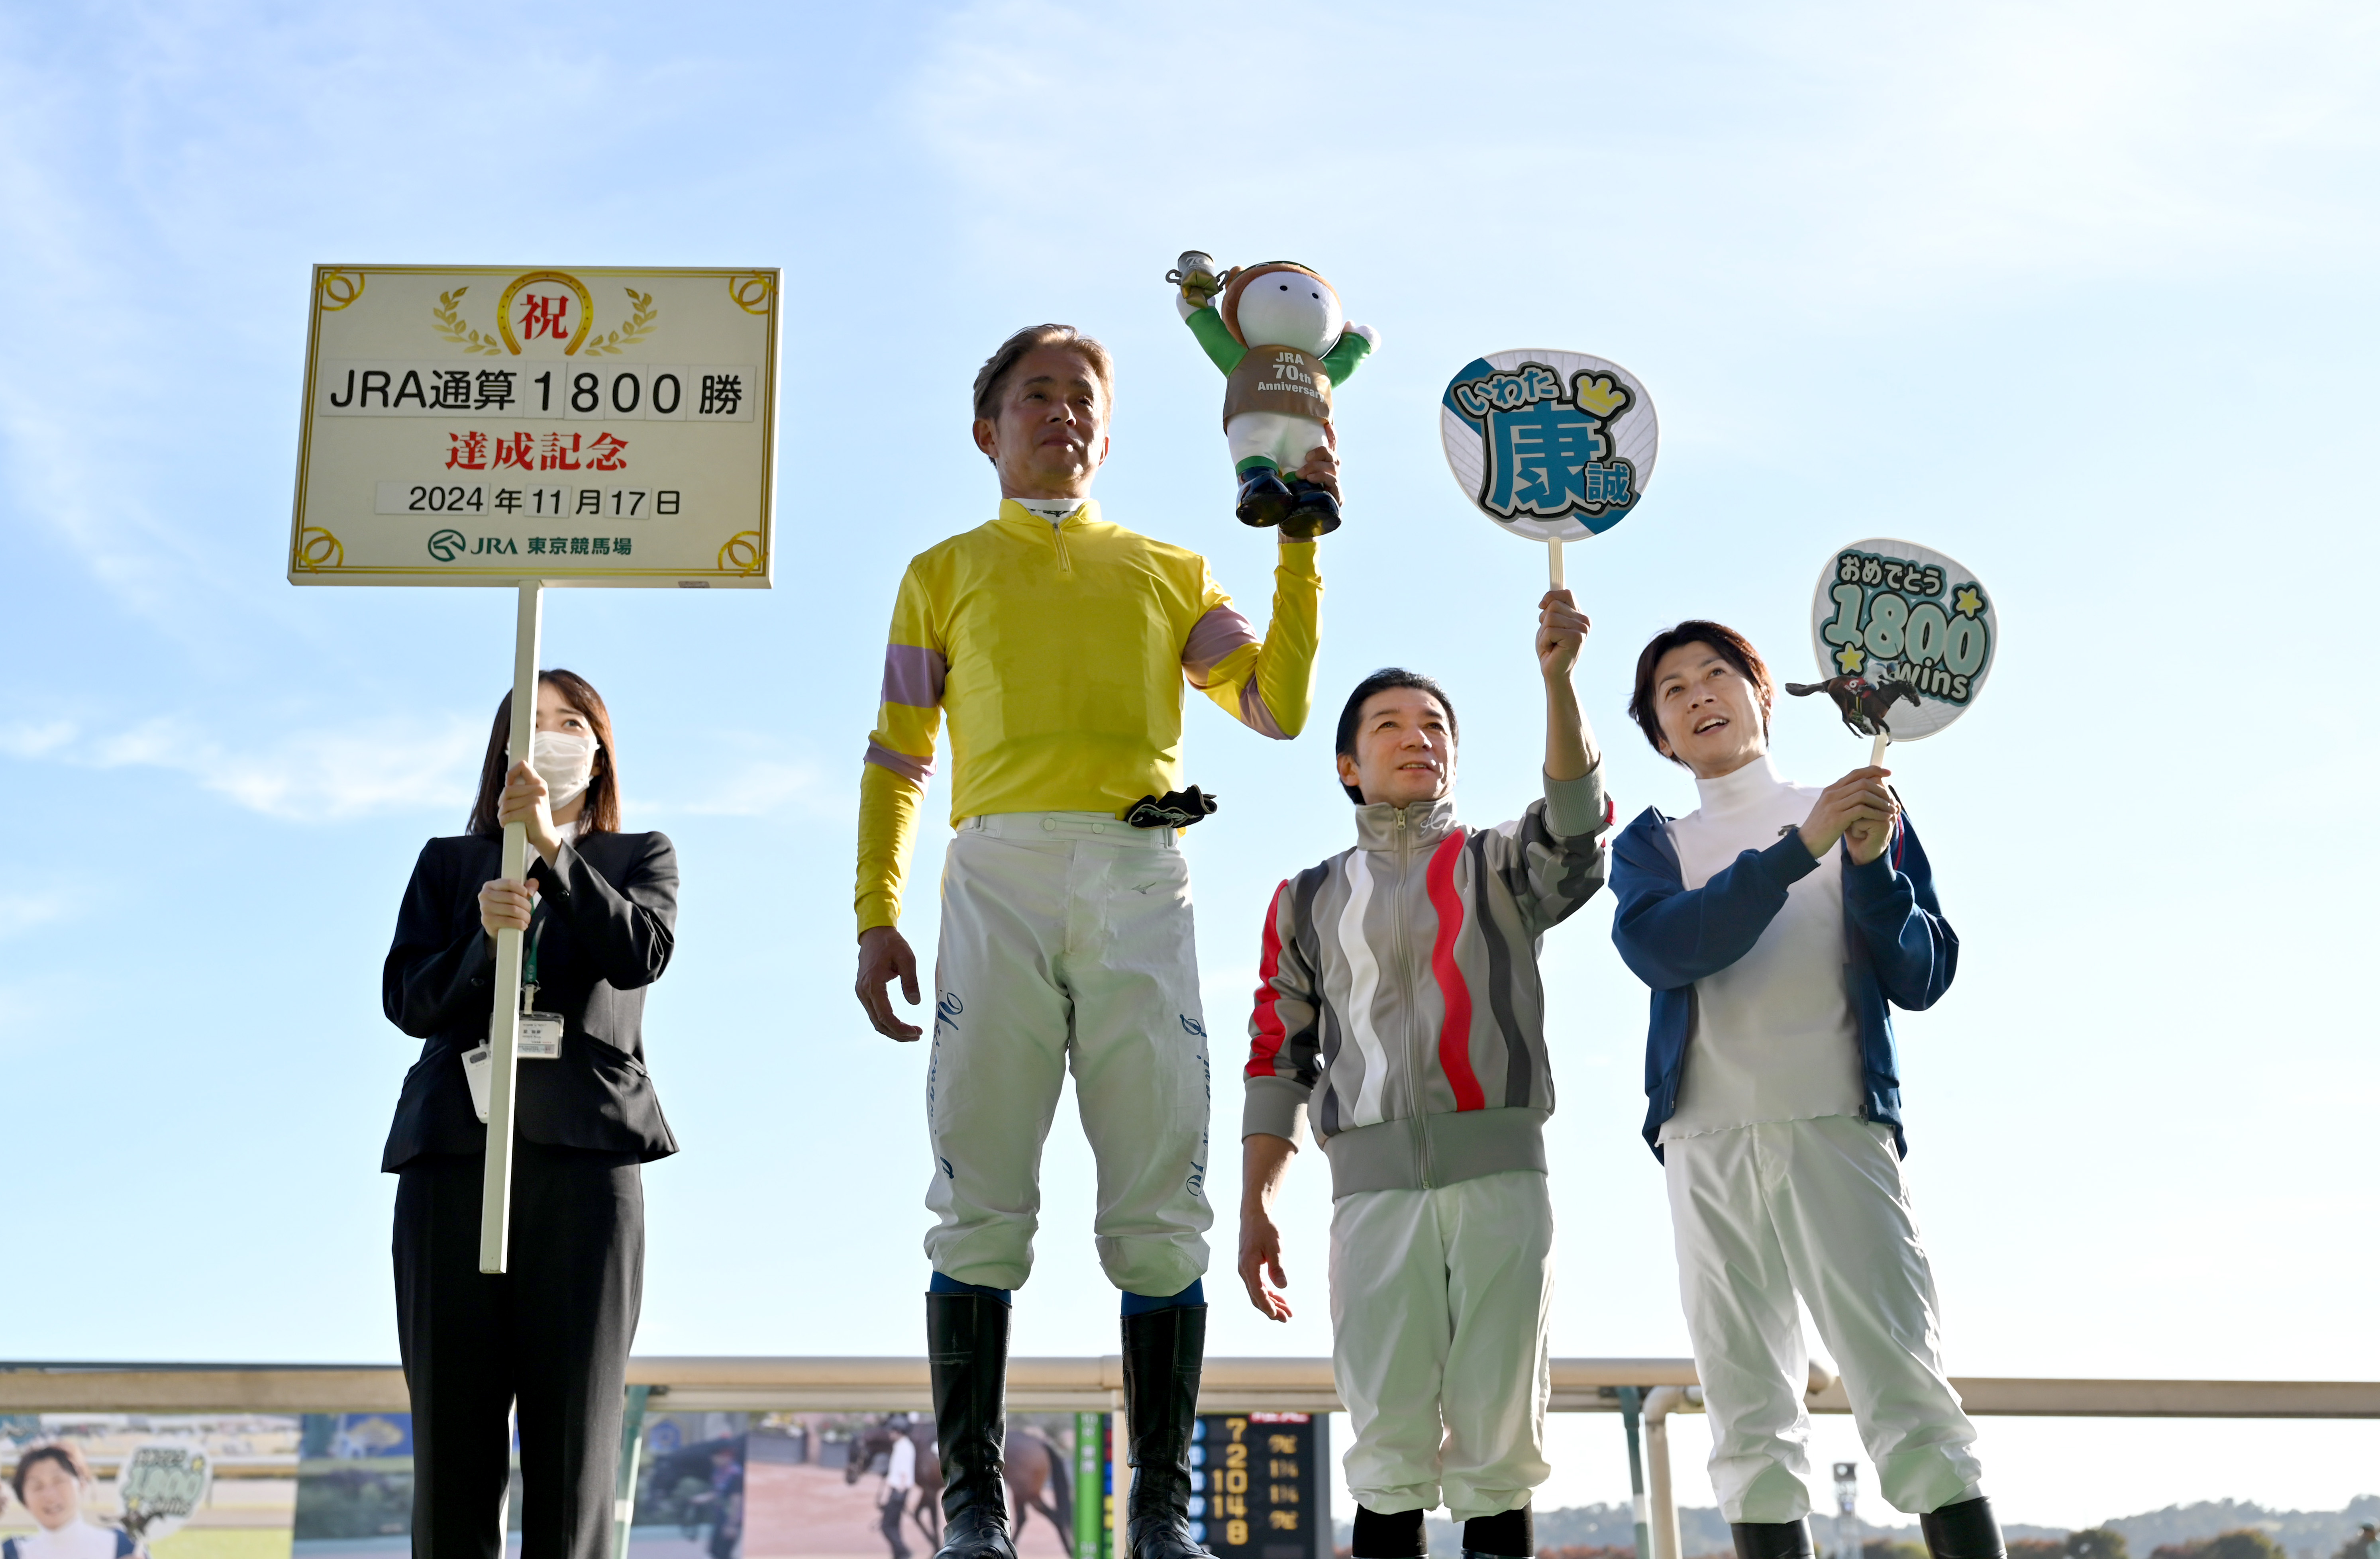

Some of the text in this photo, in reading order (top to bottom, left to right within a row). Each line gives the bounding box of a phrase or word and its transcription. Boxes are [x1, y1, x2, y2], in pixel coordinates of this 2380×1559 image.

[518, 294, 569, 339] 祝
[1275, 352, 1304, 365] JRA
[1273, 364, 1311, 384] 70th
[1258, 382, 1324, 403] Anniversary
[1461, 371, 1553, 412] いわた
[445, 431, 629, 471] 達成記念
[471, 537, 632, 555] JRA 東京競馬場
[1840, 556, 1941, 594] おめでとう
[1825, 584, 1986, 677] 1800
[1849, 680, 1859, 688] 6
[1226, 1418, 1247, 1442] 7
[1226, 1443, 1248, 1469] 2
[1213, 1468, 1248, 1494] 10
[1213, 1494, 1248, 1519] 14
[1226, 1519, 1248, 1545] 8
